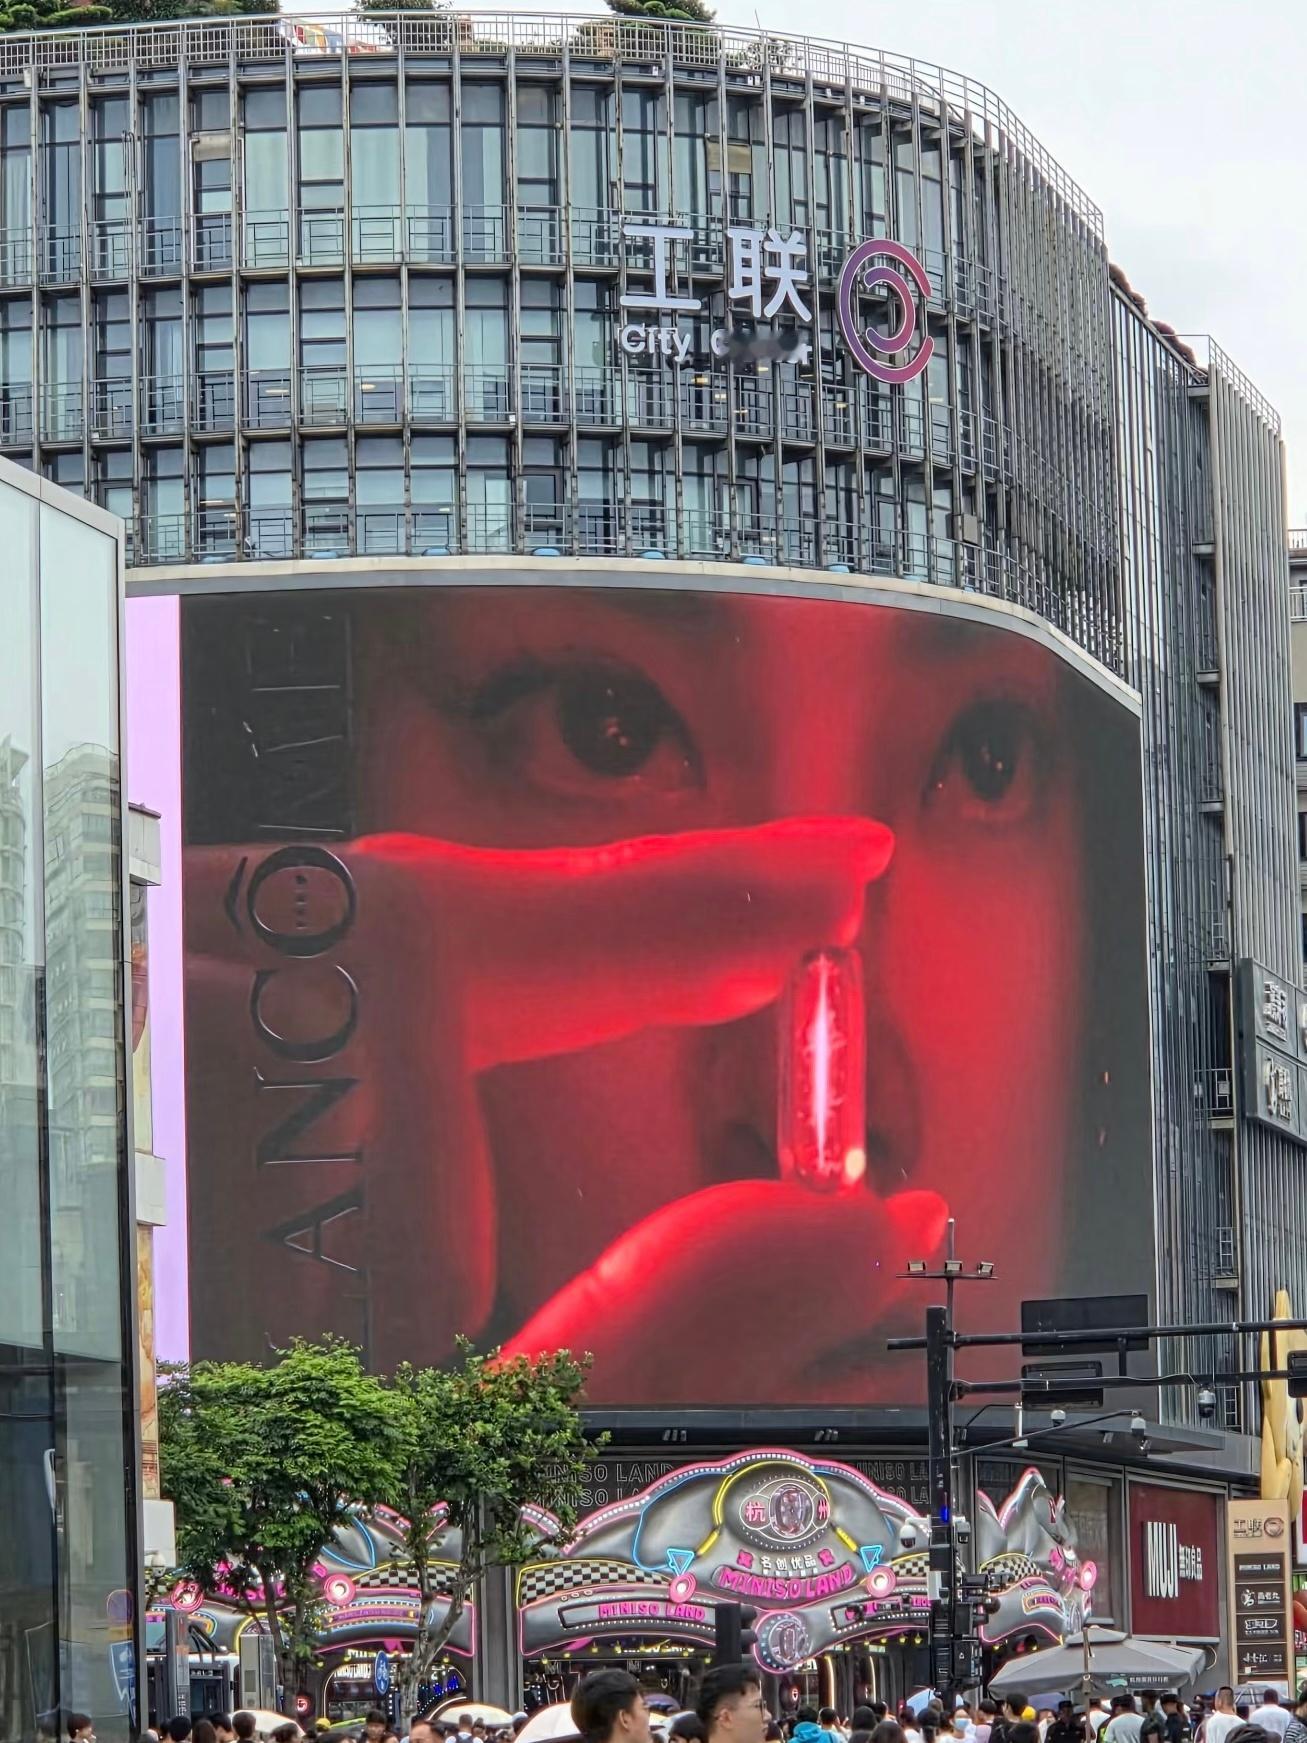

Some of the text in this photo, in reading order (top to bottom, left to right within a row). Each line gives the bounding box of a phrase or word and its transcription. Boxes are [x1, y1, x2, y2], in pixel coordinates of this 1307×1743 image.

[620, 226, 812, 322] 工联
[620, 323, 692, 362] City
[745, 1500, 766, 1522] 杭
[760, 1554, 818, 1571] 名创优品
[1146, 1521, 1179, 1599] MUJI
[718, 1561, 855, 1599] MINISO LAND
[598, 1602, 706, 1621] MINISO LAND
